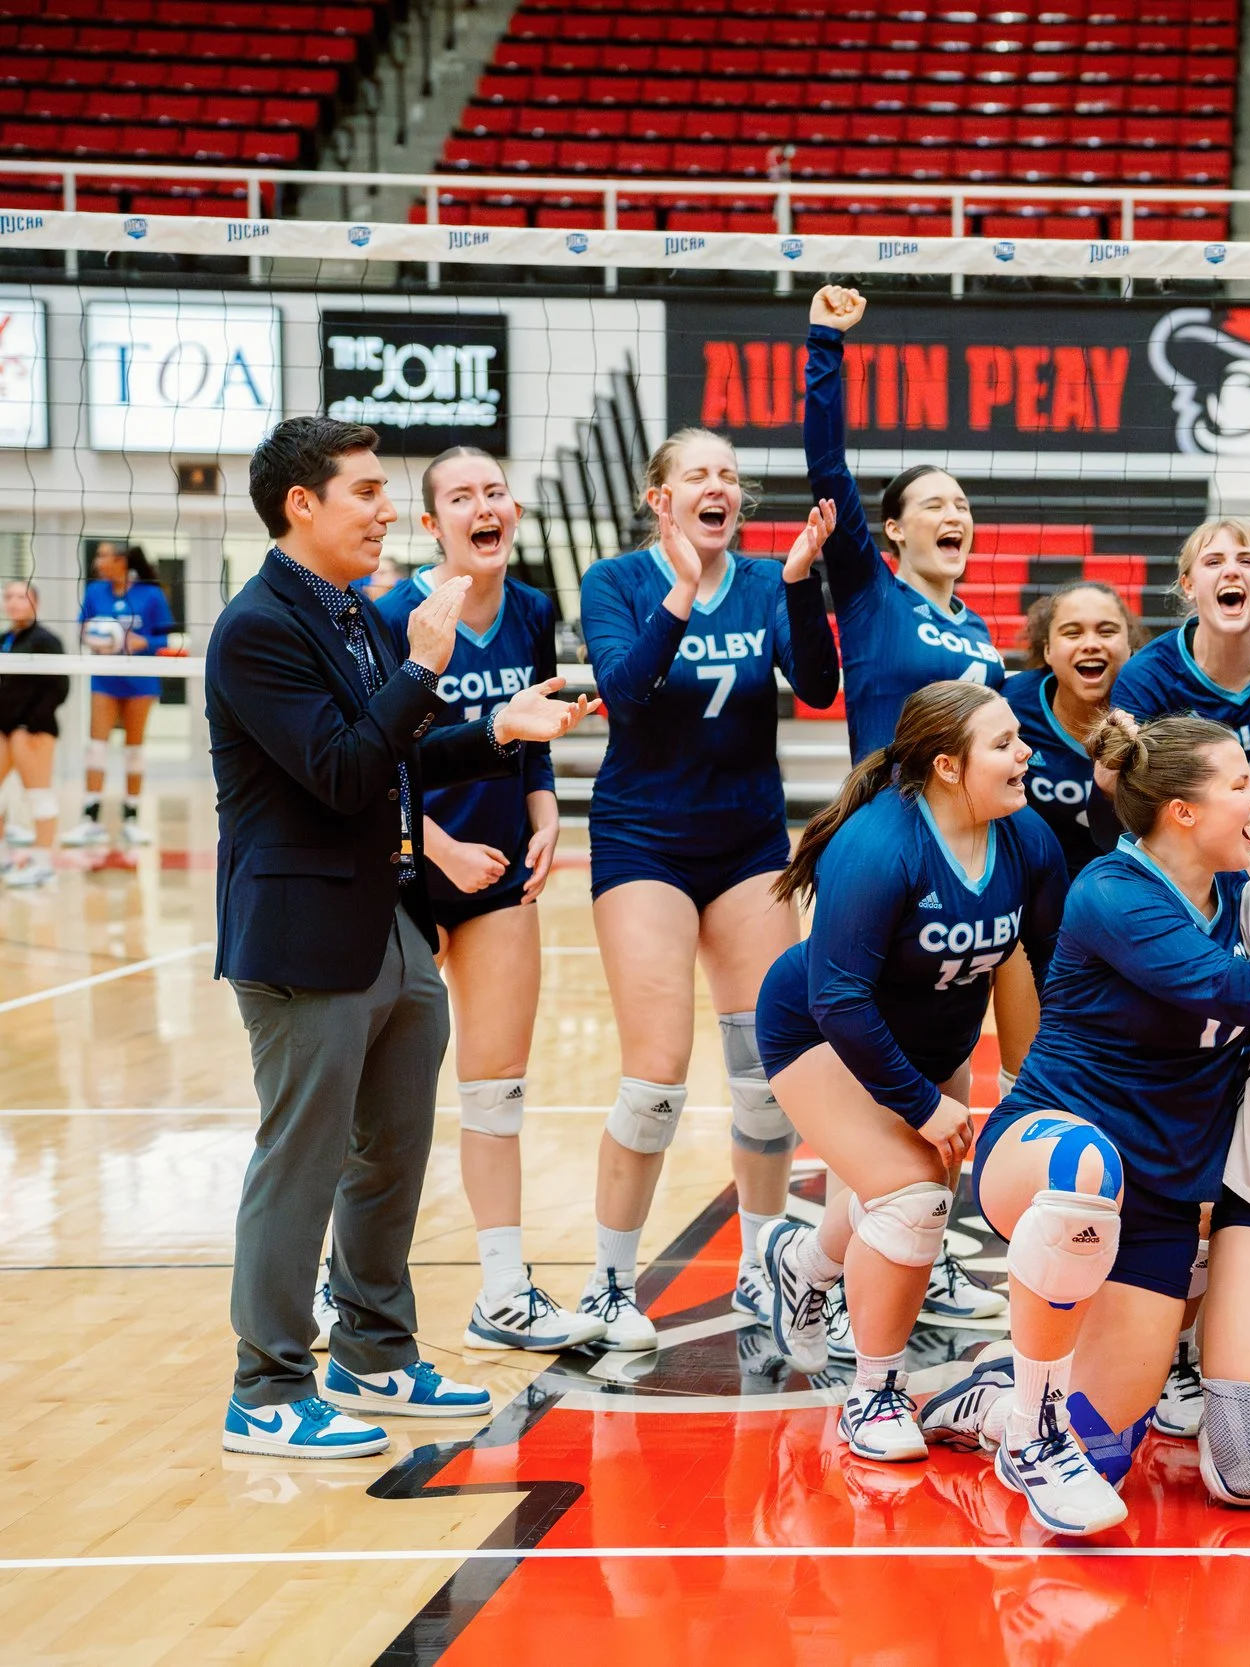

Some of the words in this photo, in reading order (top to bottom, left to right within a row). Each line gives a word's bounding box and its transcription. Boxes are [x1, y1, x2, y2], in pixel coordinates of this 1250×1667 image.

[0, 216, 43, 234] NJCAA
[227, 224, 272, 242] NJCAA
[448, 231, 490, 250] NJCAA
[664, 238, 706, 256] NJCAA
[878, 242, 919, 261] NJCAA
[1089, 245, 1130, 264] NJCAA
[328, 336, 384, 371] THE
[89, 340, 267, 407] TOA
[701, 341, 949, 430] AUTIN
[965, 346, 1129, 433] PEAY
[675, 629, 766, 661] OLBY
[436, 666, 534, 703] COLBY
[696, 663, 737, 719] 7
[918, 901, 943, 910] adidas
[918, 904, 1024, 953] COLBY
